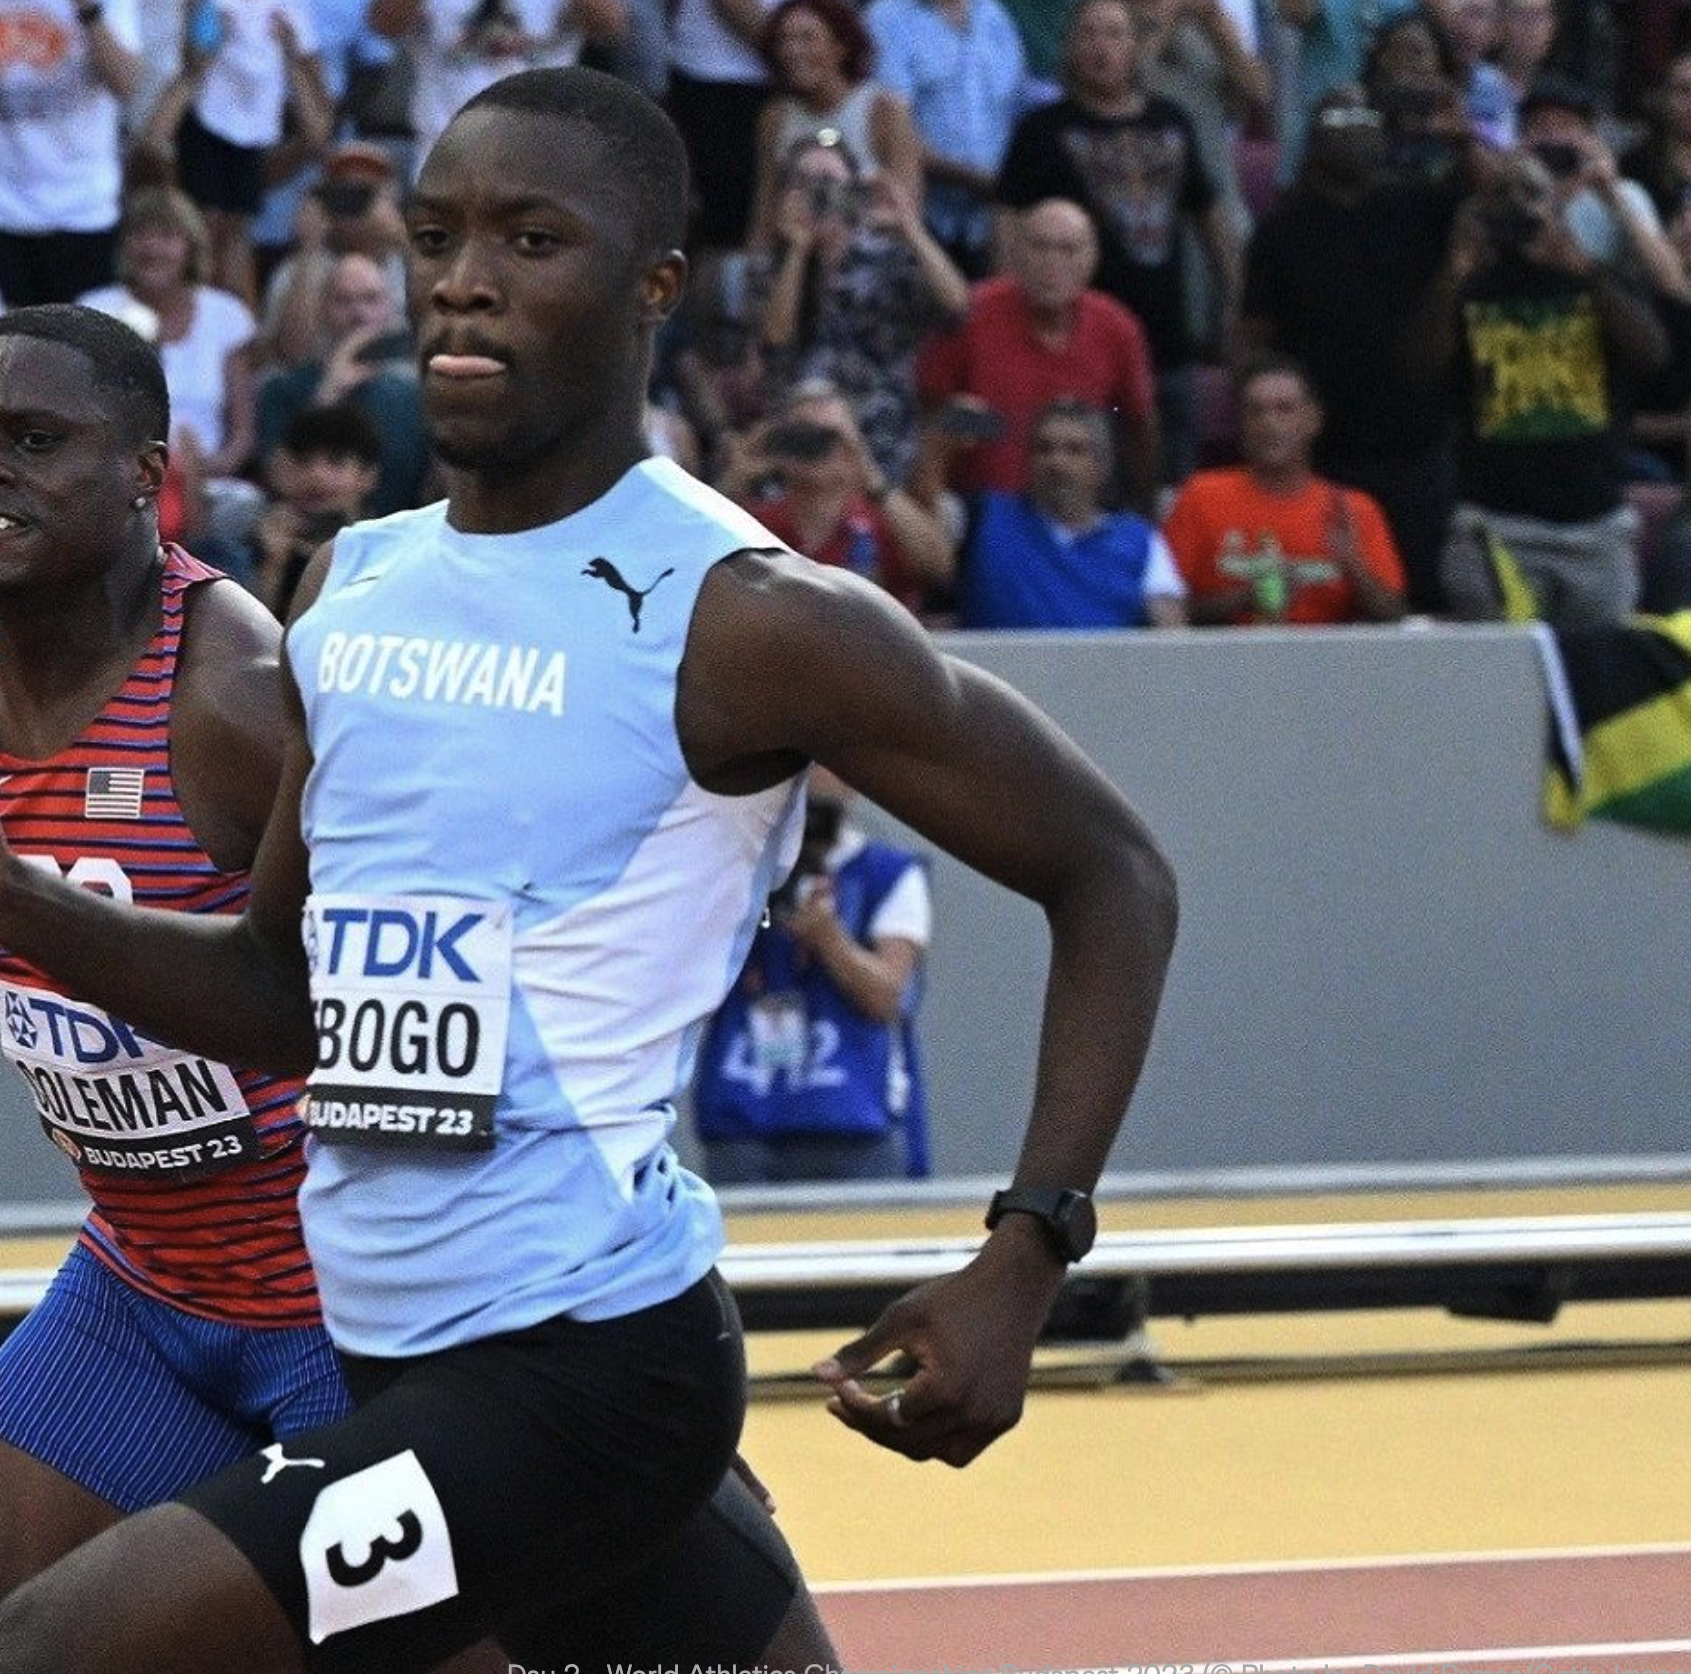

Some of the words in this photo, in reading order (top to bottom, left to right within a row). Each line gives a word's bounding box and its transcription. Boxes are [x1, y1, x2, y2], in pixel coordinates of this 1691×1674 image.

[318, 631, 566, 717] BOTSWANA
[323, 908, 485, 983] TDK
[82, 1143, 205, 1171] BUDAPEST
[205, 1134, 243, 1159] 23
[435, 1107, 474, 1136] 23
[325, 1508, 424, 1588] 3
